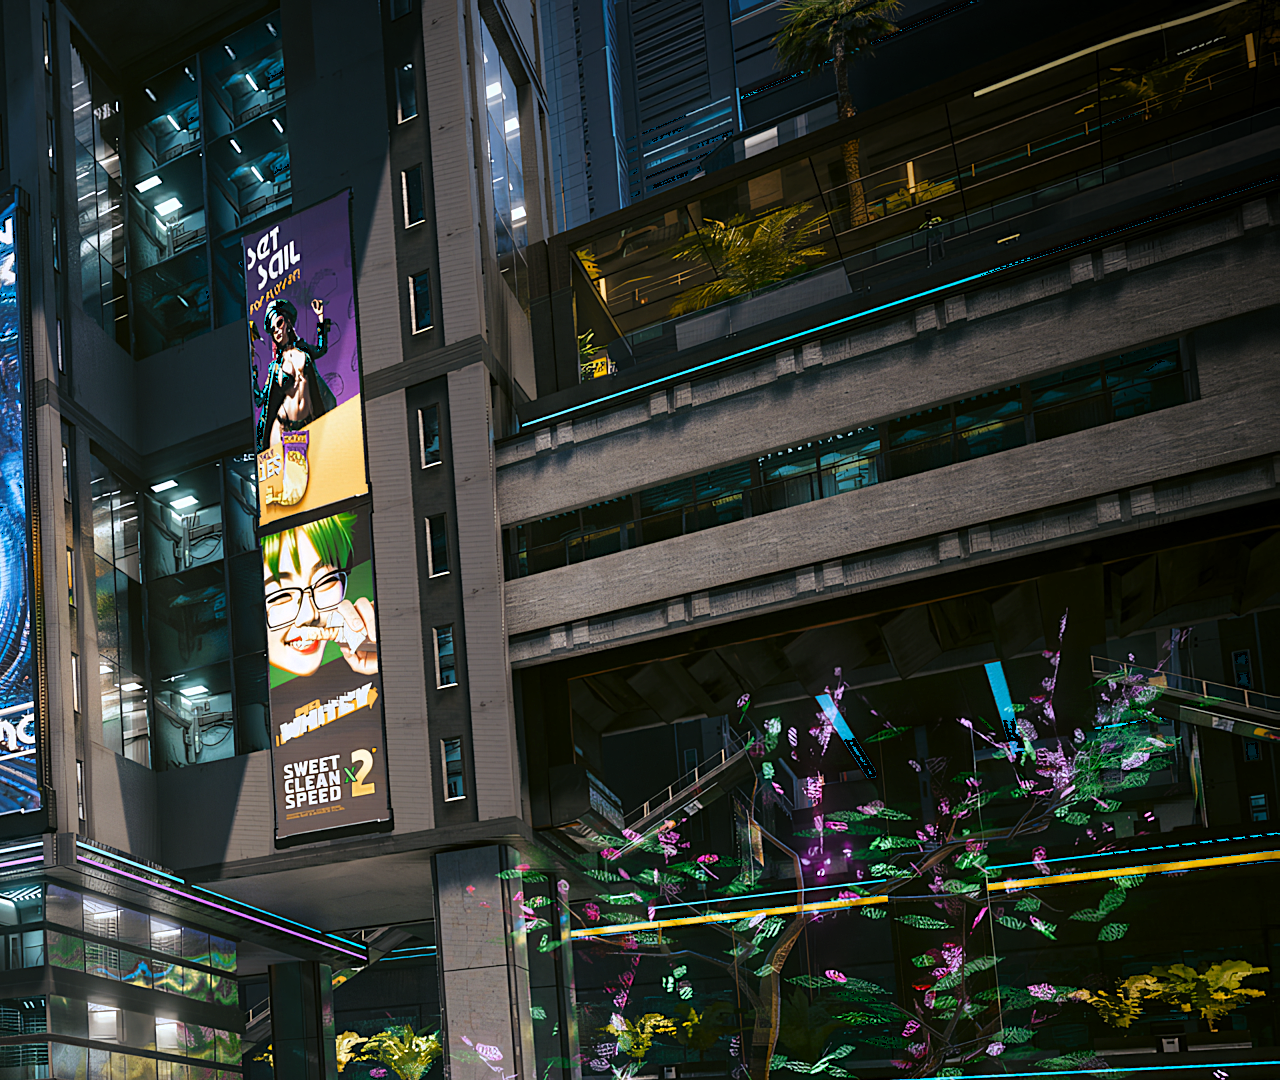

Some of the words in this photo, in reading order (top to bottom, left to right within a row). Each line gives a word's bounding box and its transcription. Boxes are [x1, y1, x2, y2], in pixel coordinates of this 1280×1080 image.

[283, 754, 341, 779] SWEET
[284, 770, 341, 794] CLEAN
[285, 785, 342, 810] SPEED
